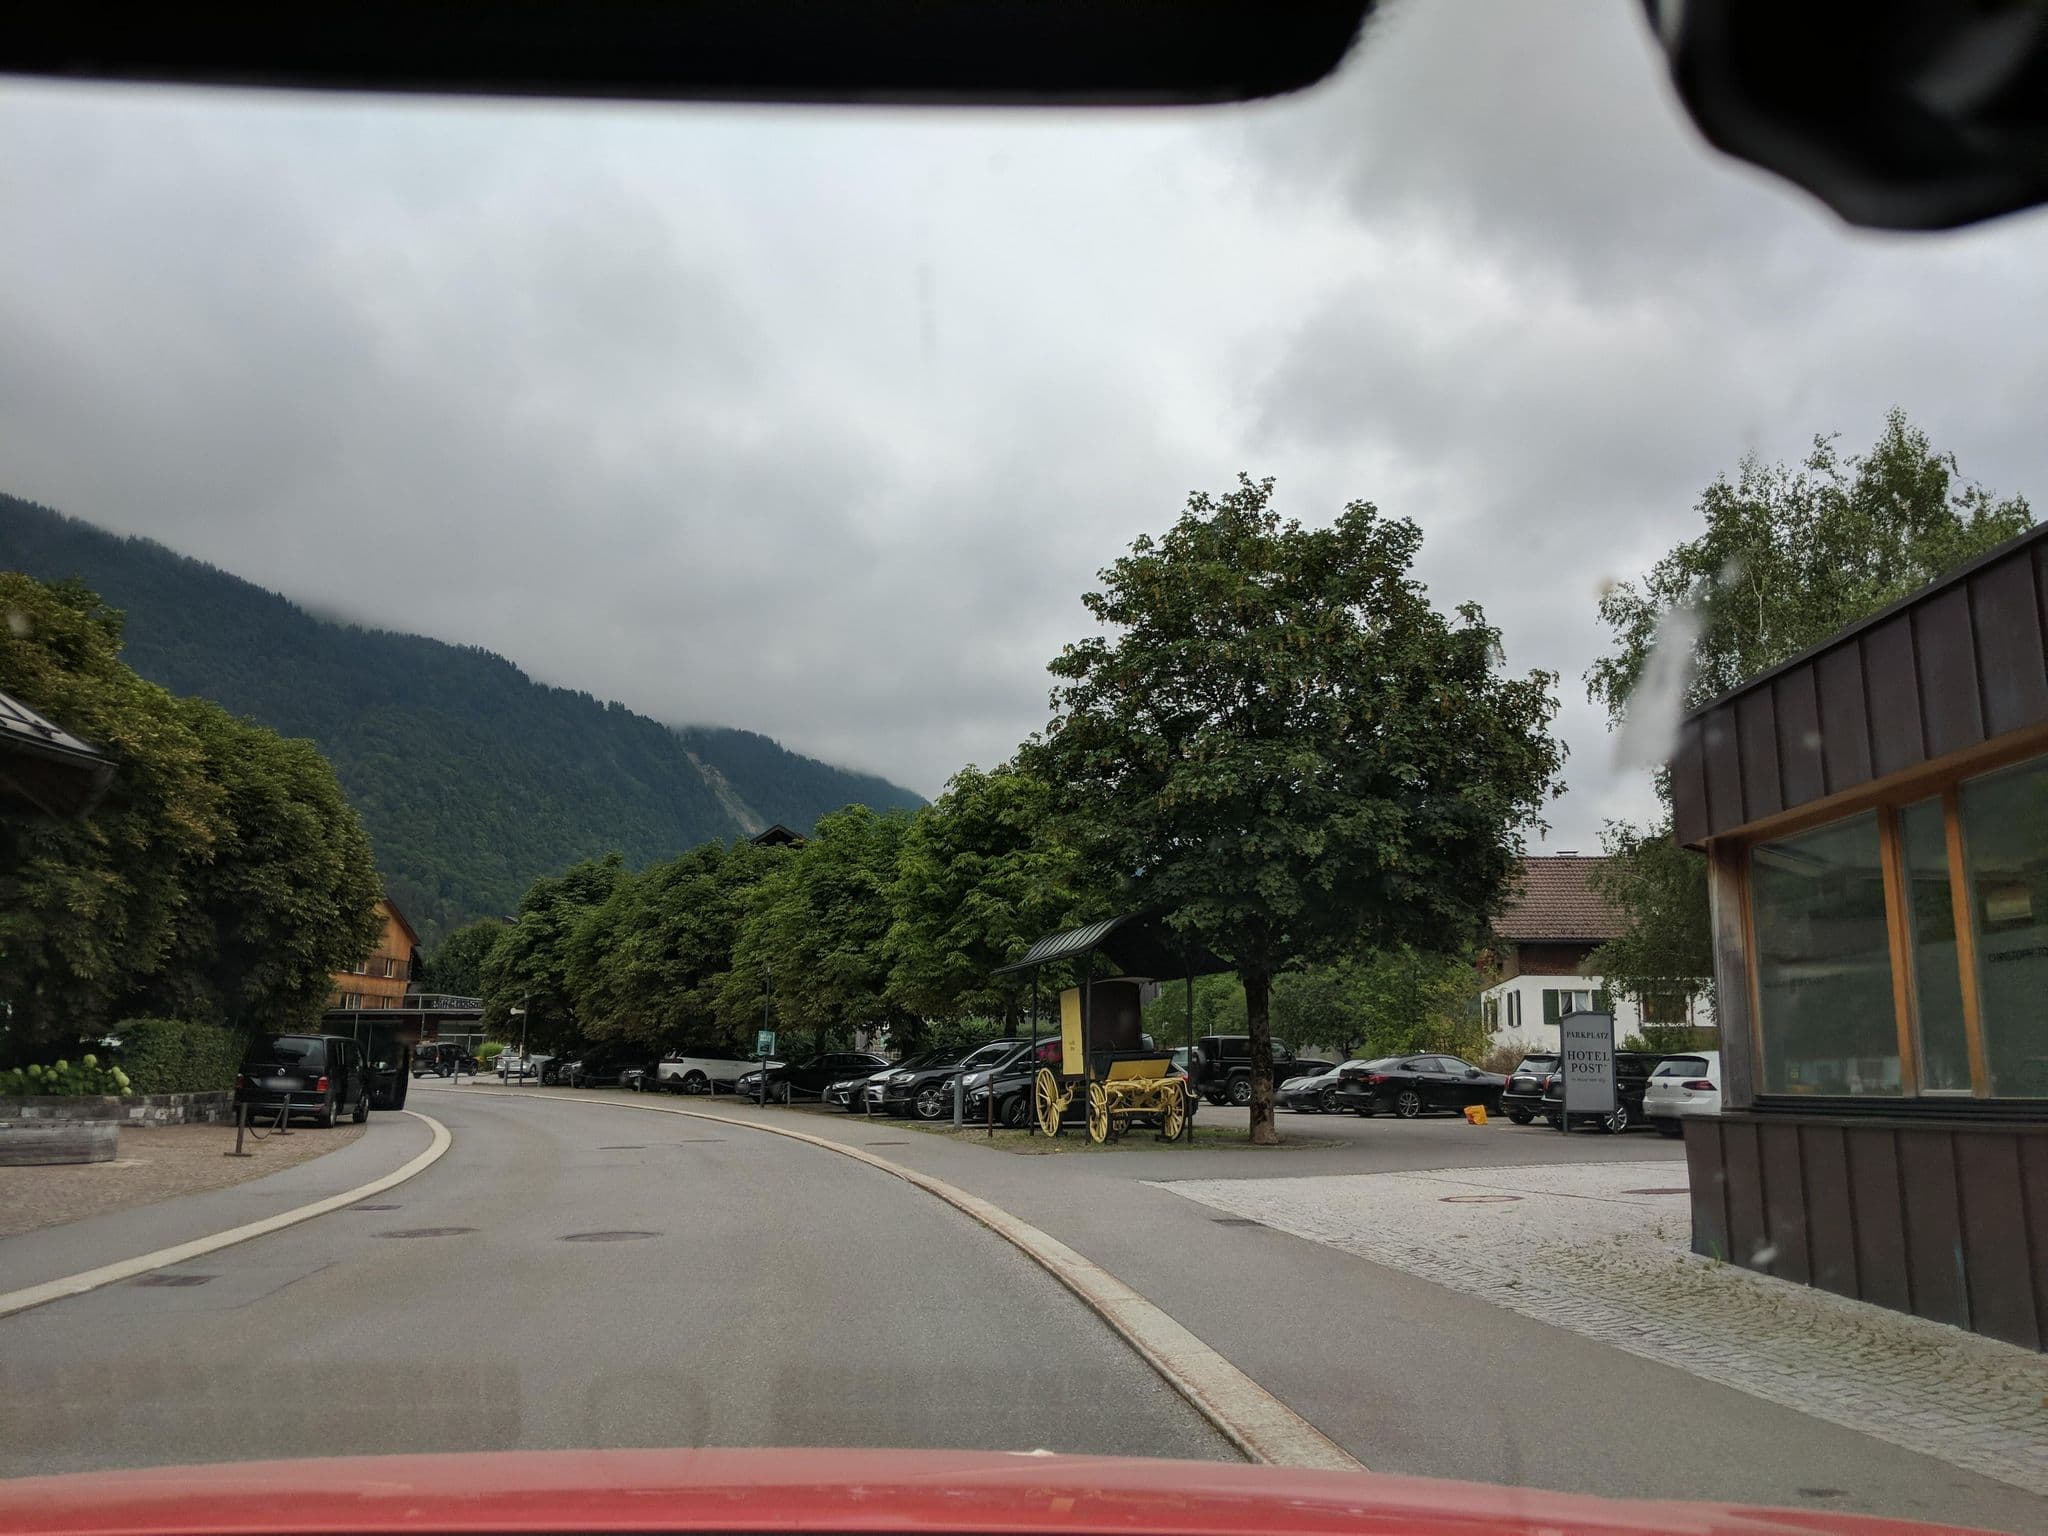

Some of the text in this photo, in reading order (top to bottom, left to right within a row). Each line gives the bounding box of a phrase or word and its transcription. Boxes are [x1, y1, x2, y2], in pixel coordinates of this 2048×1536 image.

[1566, 1031, 1609, 1039] PARKPLATZ
[1567, 1050, 1610, 1061] HOTEL
[1571, 1063, 1603, 1073] POST
